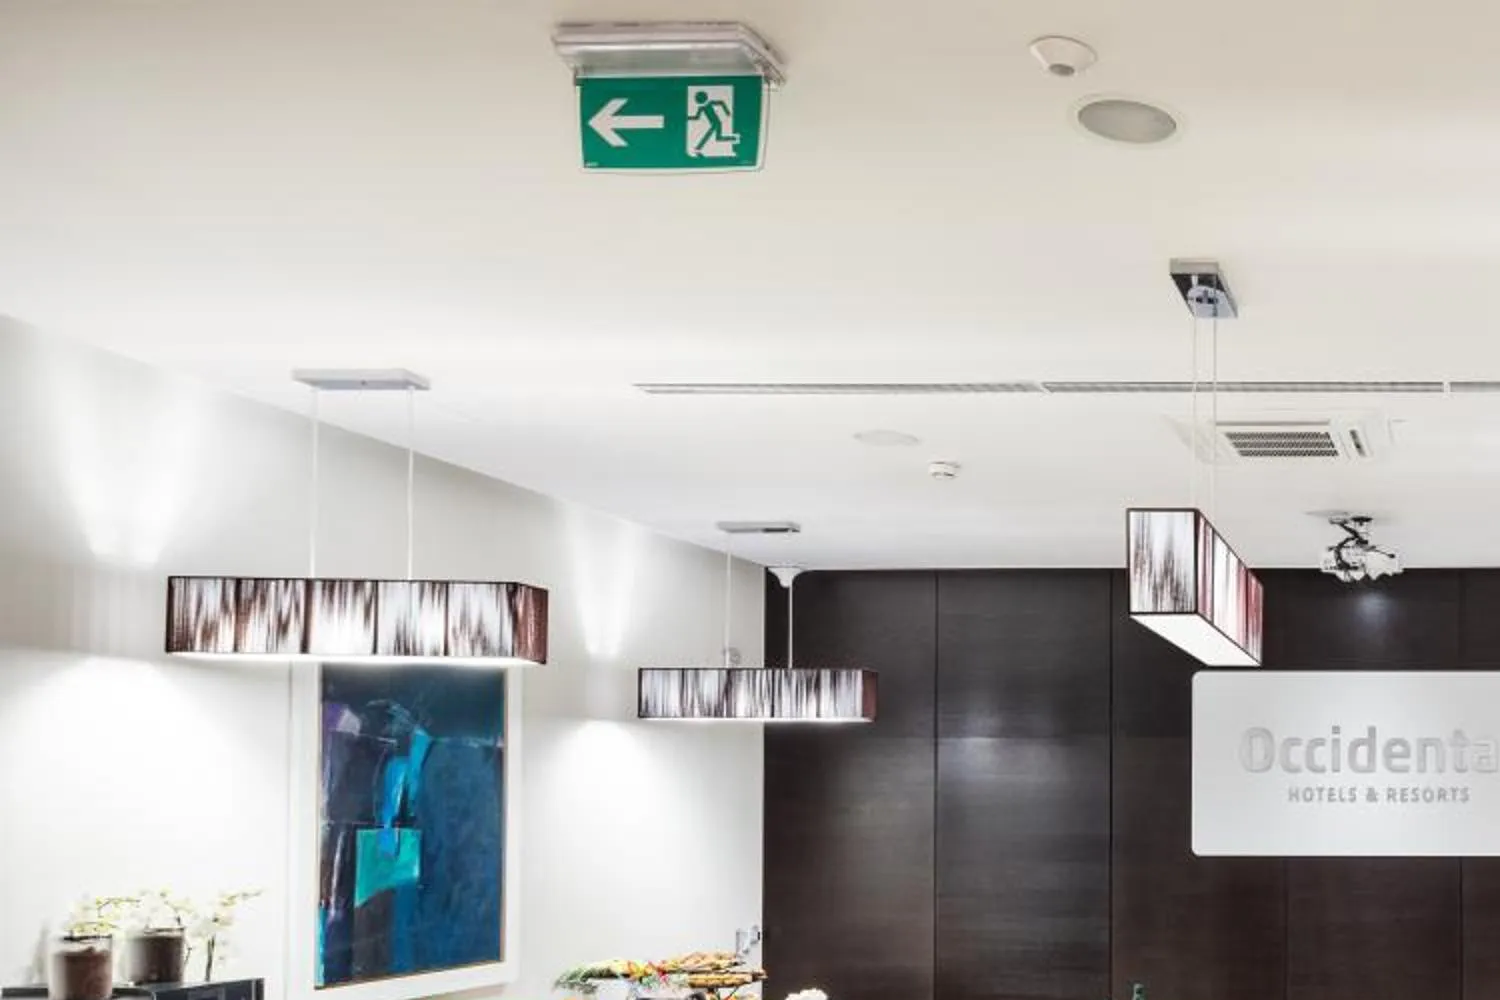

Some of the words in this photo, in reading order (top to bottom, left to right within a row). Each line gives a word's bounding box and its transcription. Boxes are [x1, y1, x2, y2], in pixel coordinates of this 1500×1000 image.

[1288, 787, 1357, 803] HOTELS
[1366, 787, 1379, 803] &
[1387, 787, 1471, 803] RESORTS
